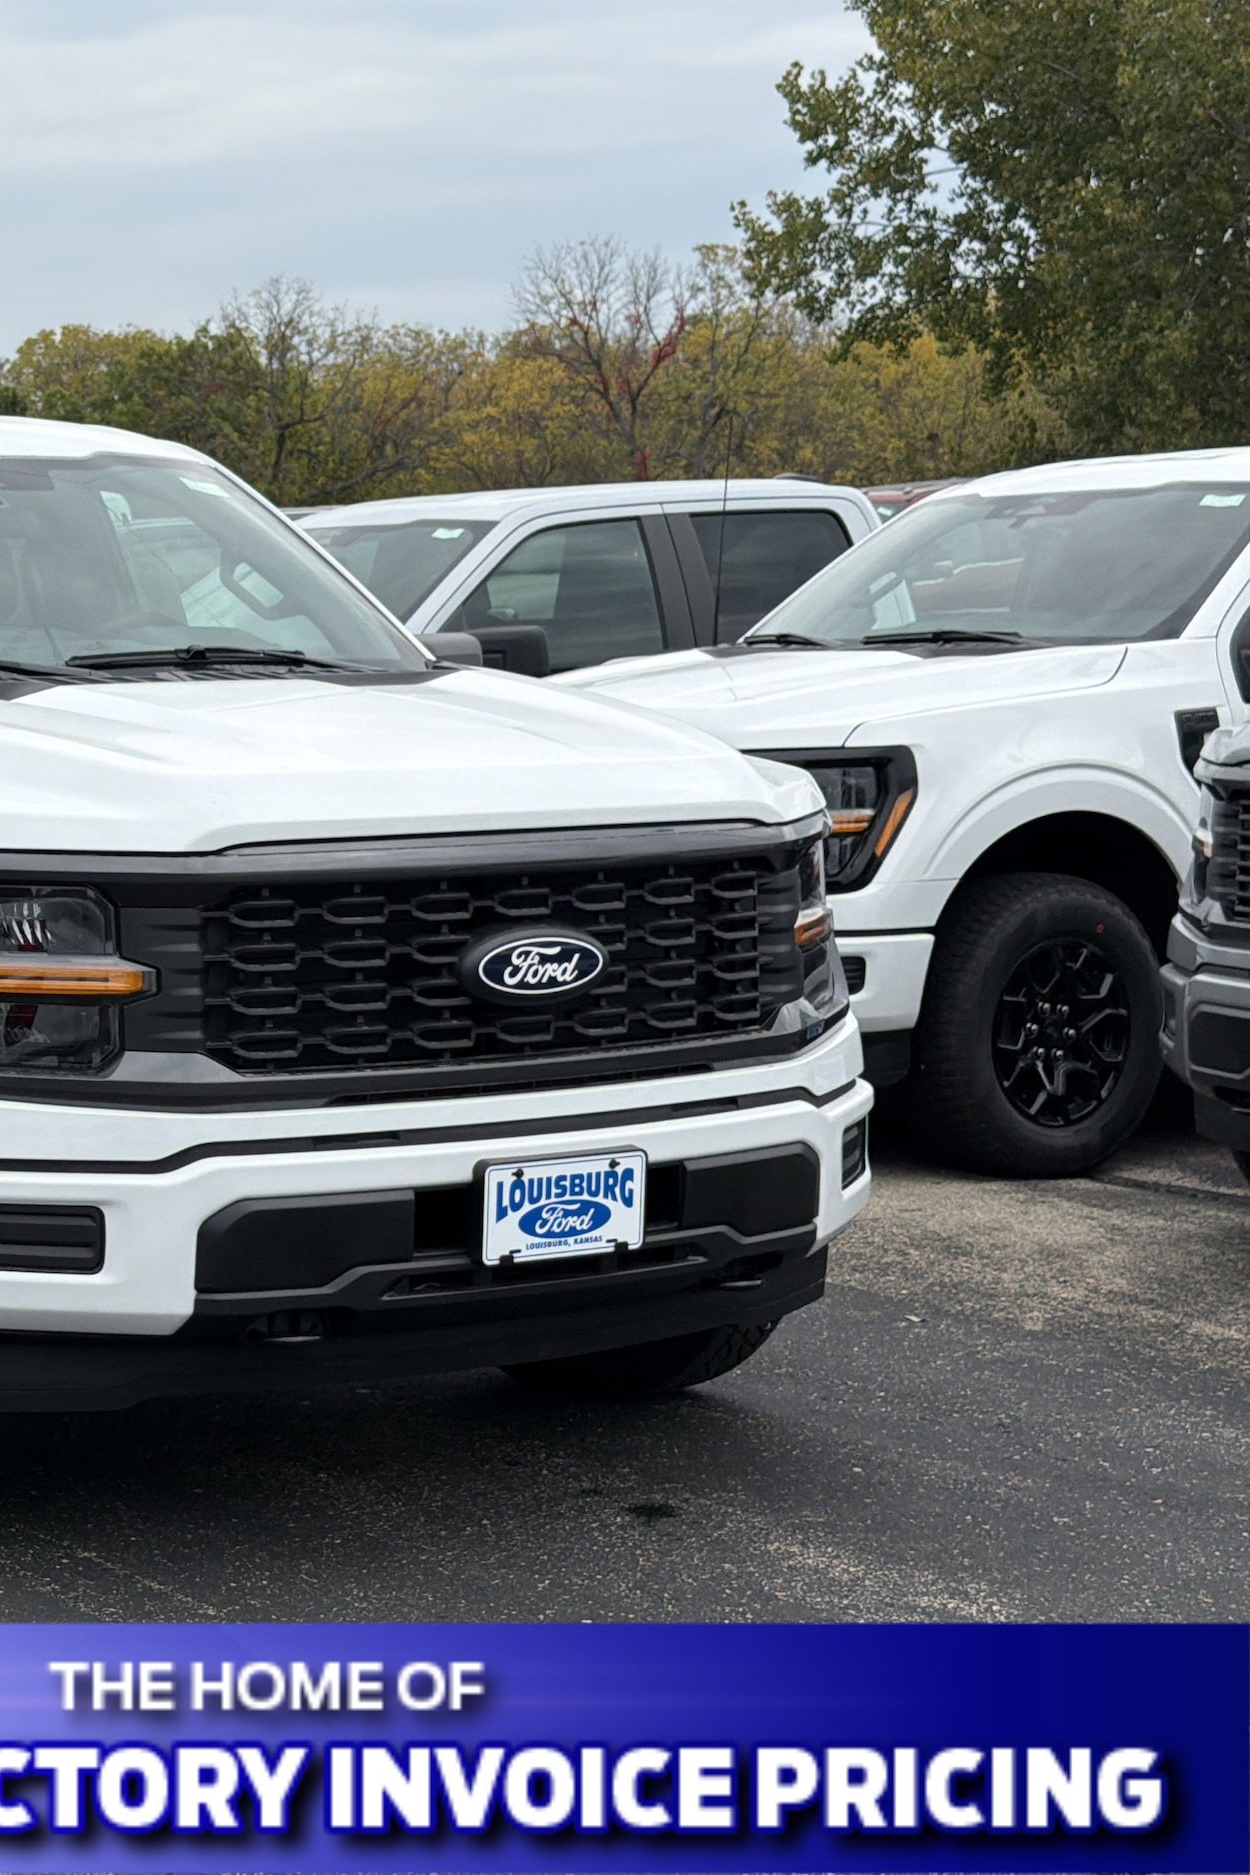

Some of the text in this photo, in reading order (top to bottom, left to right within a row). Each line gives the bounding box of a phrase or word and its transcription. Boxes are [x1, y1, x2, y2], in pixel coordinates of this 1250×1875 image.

[503, 946, 580, 985] Ford
[495, 1167, 635, 1224] LOUISBURG
[534, 1202, 596, 1235] Ford
[525, 1235, 603, 1251] LOUISBURG, KANSAS
